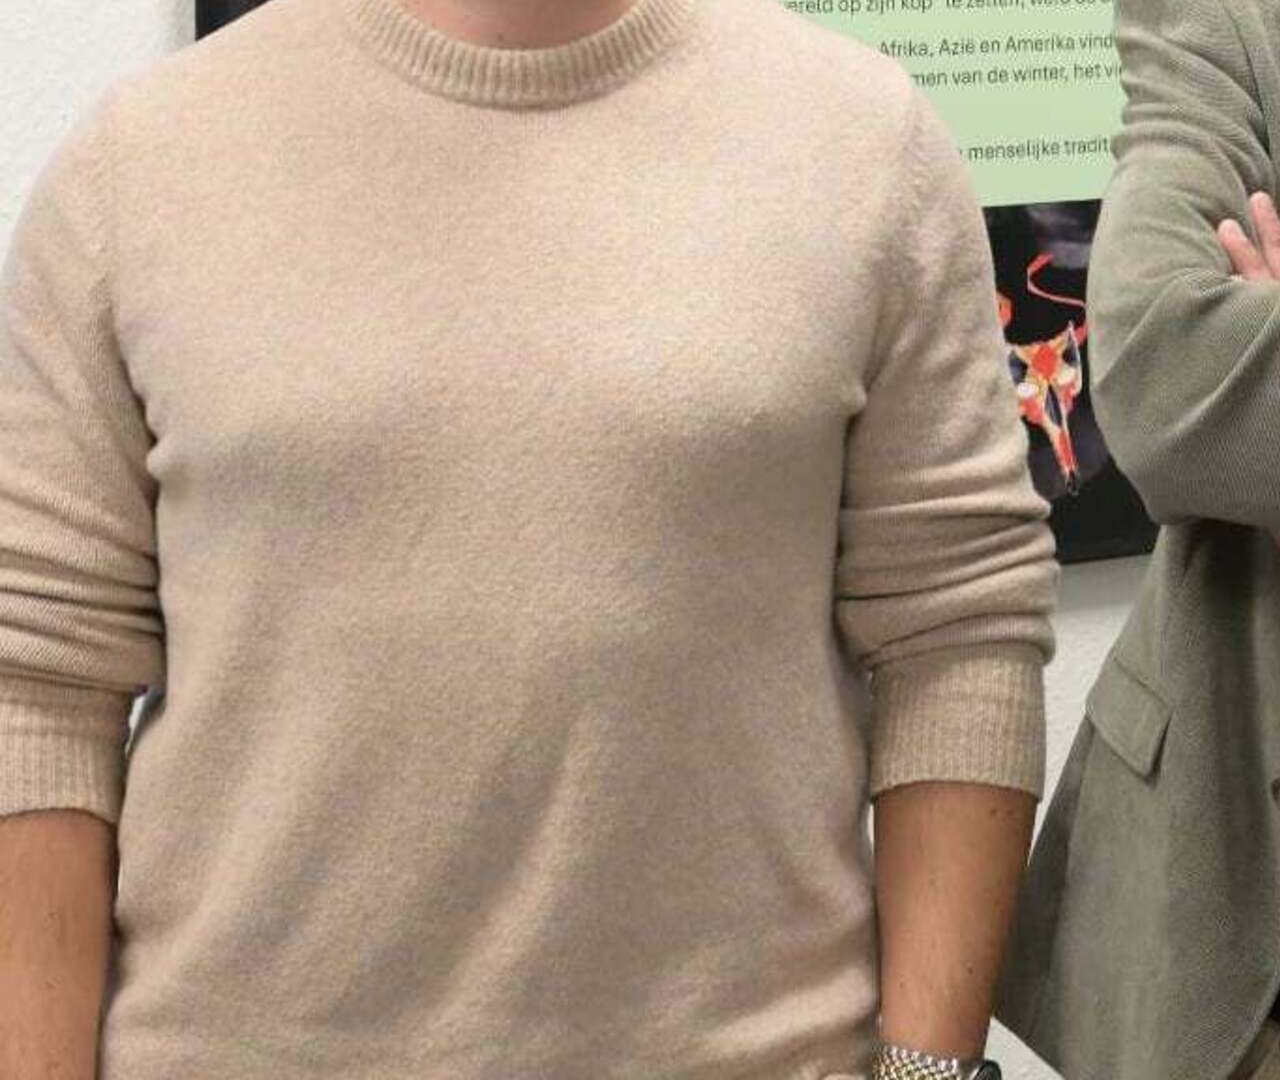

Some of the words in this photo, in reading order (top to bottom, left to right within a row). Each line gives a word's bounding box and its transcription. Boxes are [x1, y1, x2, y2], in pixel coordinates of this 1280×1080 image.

[937, 36, 976, 57] Azië
[978, 38, 1001, 54] en
[1003, 31, 1076, 54] Amerika
[967, 137, 1061, 162] menselijke
